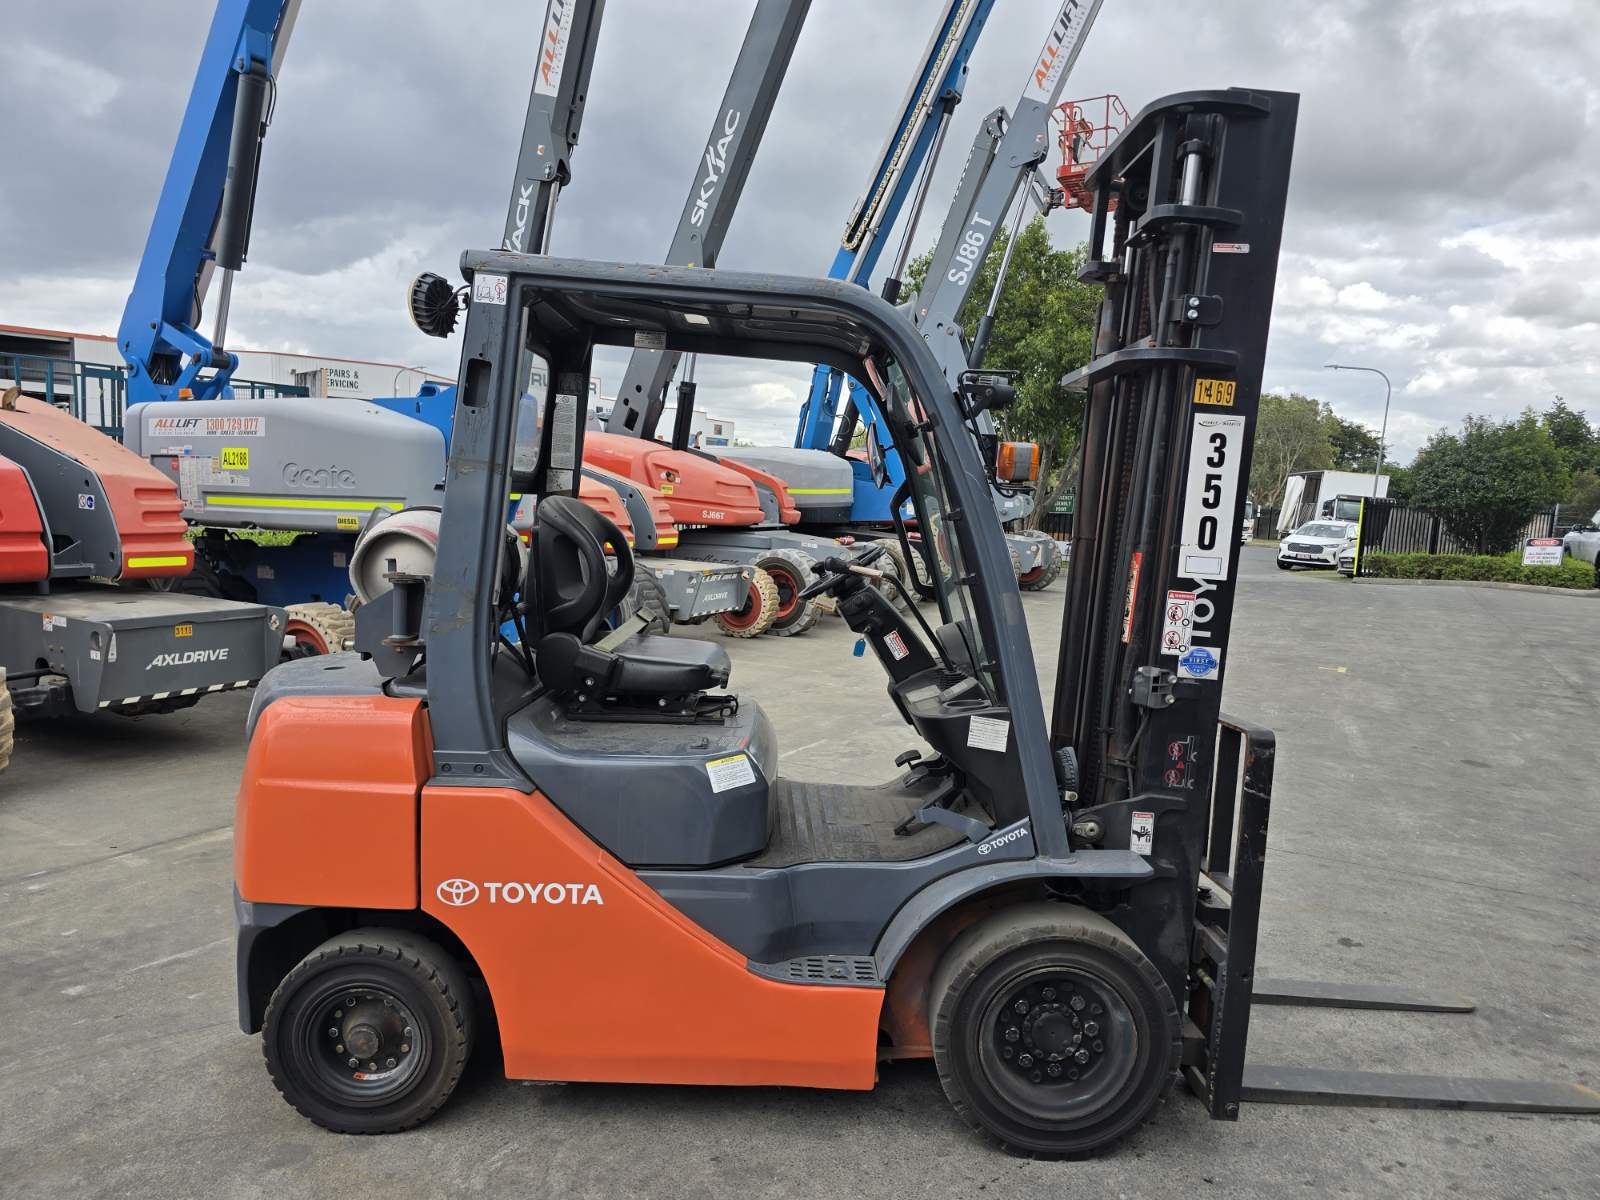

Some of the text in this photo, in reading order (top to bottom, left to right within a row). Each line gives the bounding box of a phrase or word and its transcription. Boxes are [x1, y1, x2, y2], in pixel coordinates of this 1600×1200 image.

[948, 230, 985, 286] SJ86
[328, 368, 351, 378] PAIRS
[1198, 381, 1233, 404] 1469
[206, 418, 225, 430] 1300
[244, 418, 259, 430] 077
[282, 462, 356, 489] Genie
[702, 510, 725, 520] SJ66T
[145, 648, 229, 671] AXLDRIVE
[990, 827, 1029, 849] TOYOTA
[483, 881, 604, 905] TOYOTA
